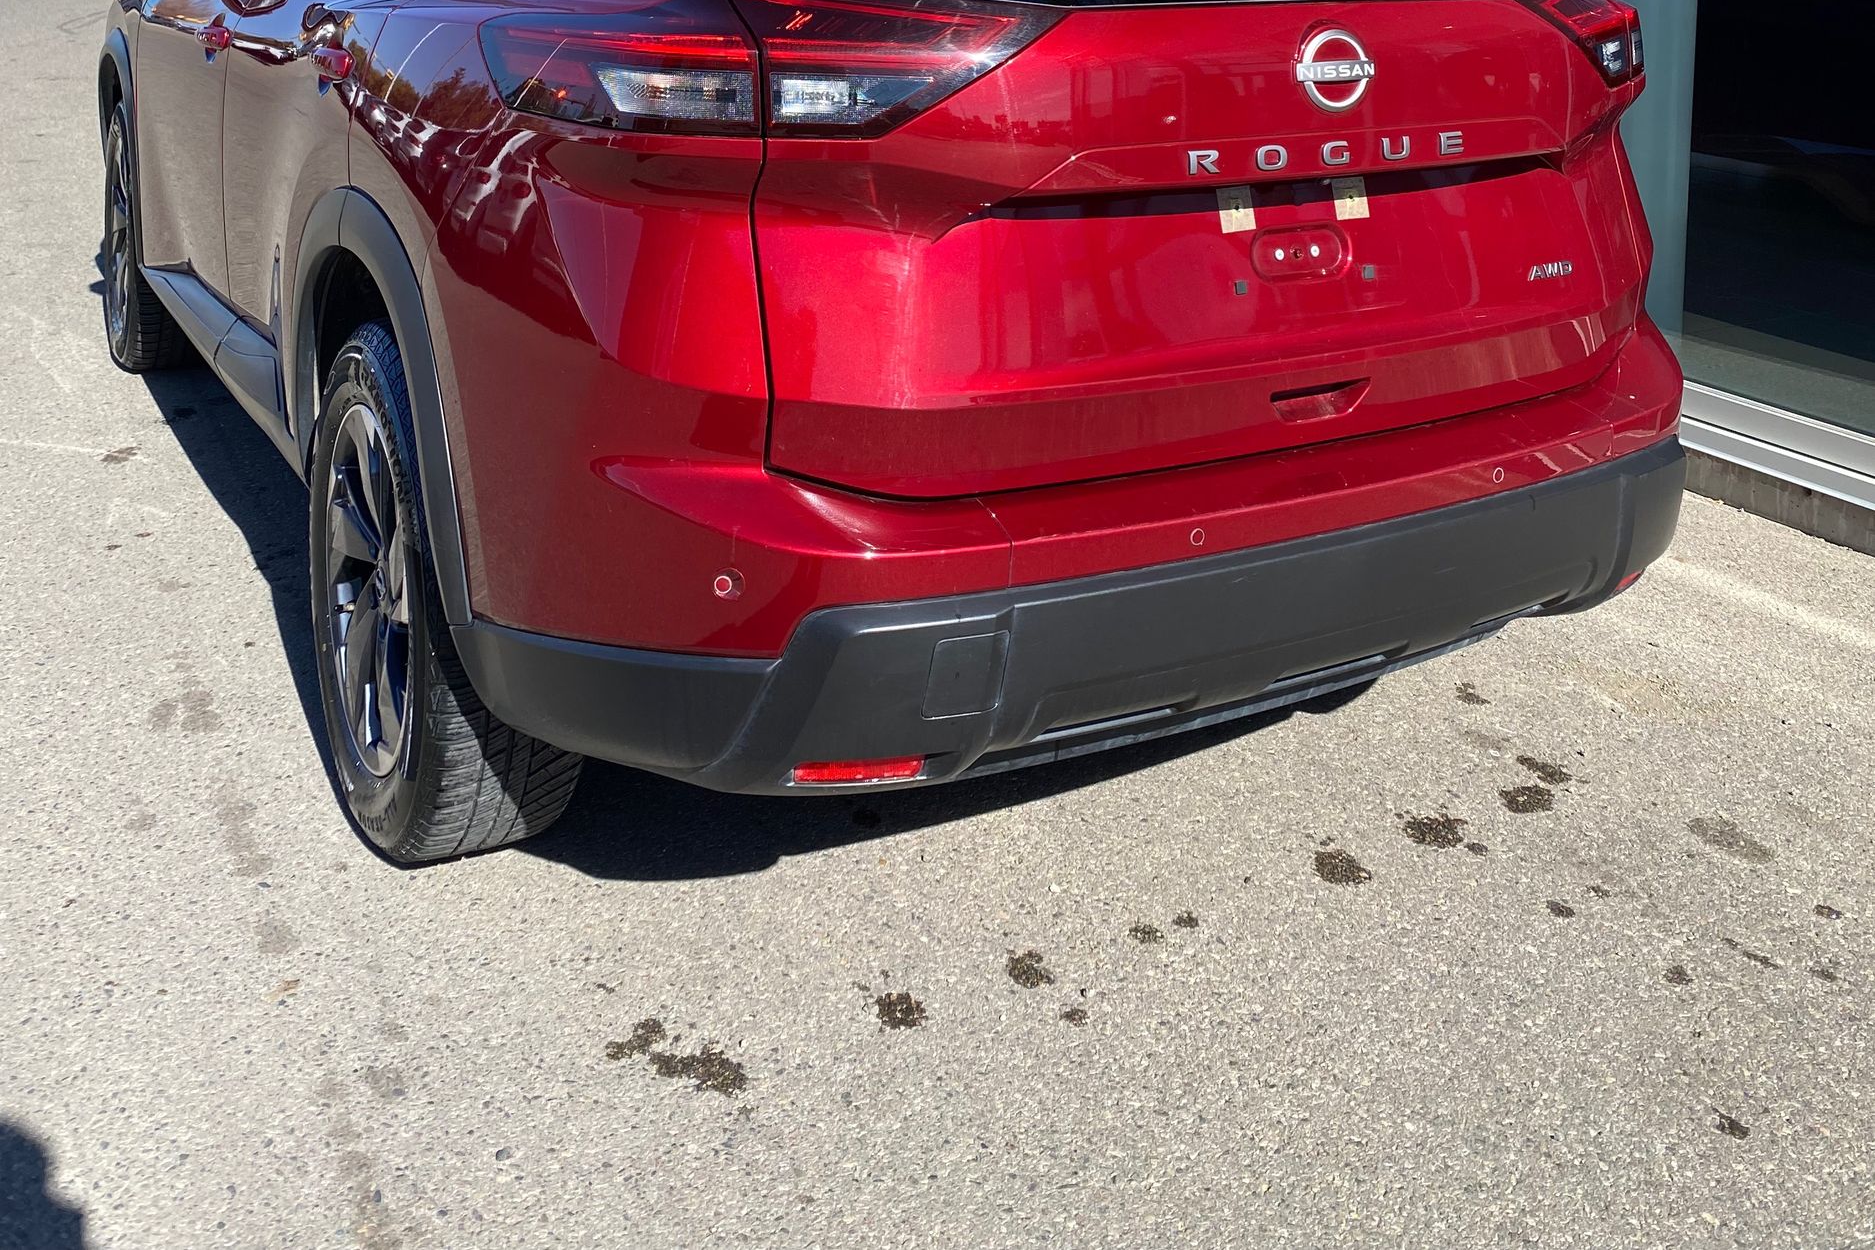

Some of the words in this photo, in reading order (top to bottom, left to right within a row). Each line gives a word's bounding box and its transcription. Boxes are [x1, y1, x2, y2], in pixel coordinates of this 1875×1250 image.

[1299, 63, 1375, 79] NISSAN
[1187, 130, 1465, 175] ROGUE
[1527, 260, 1573, 281] AWD
